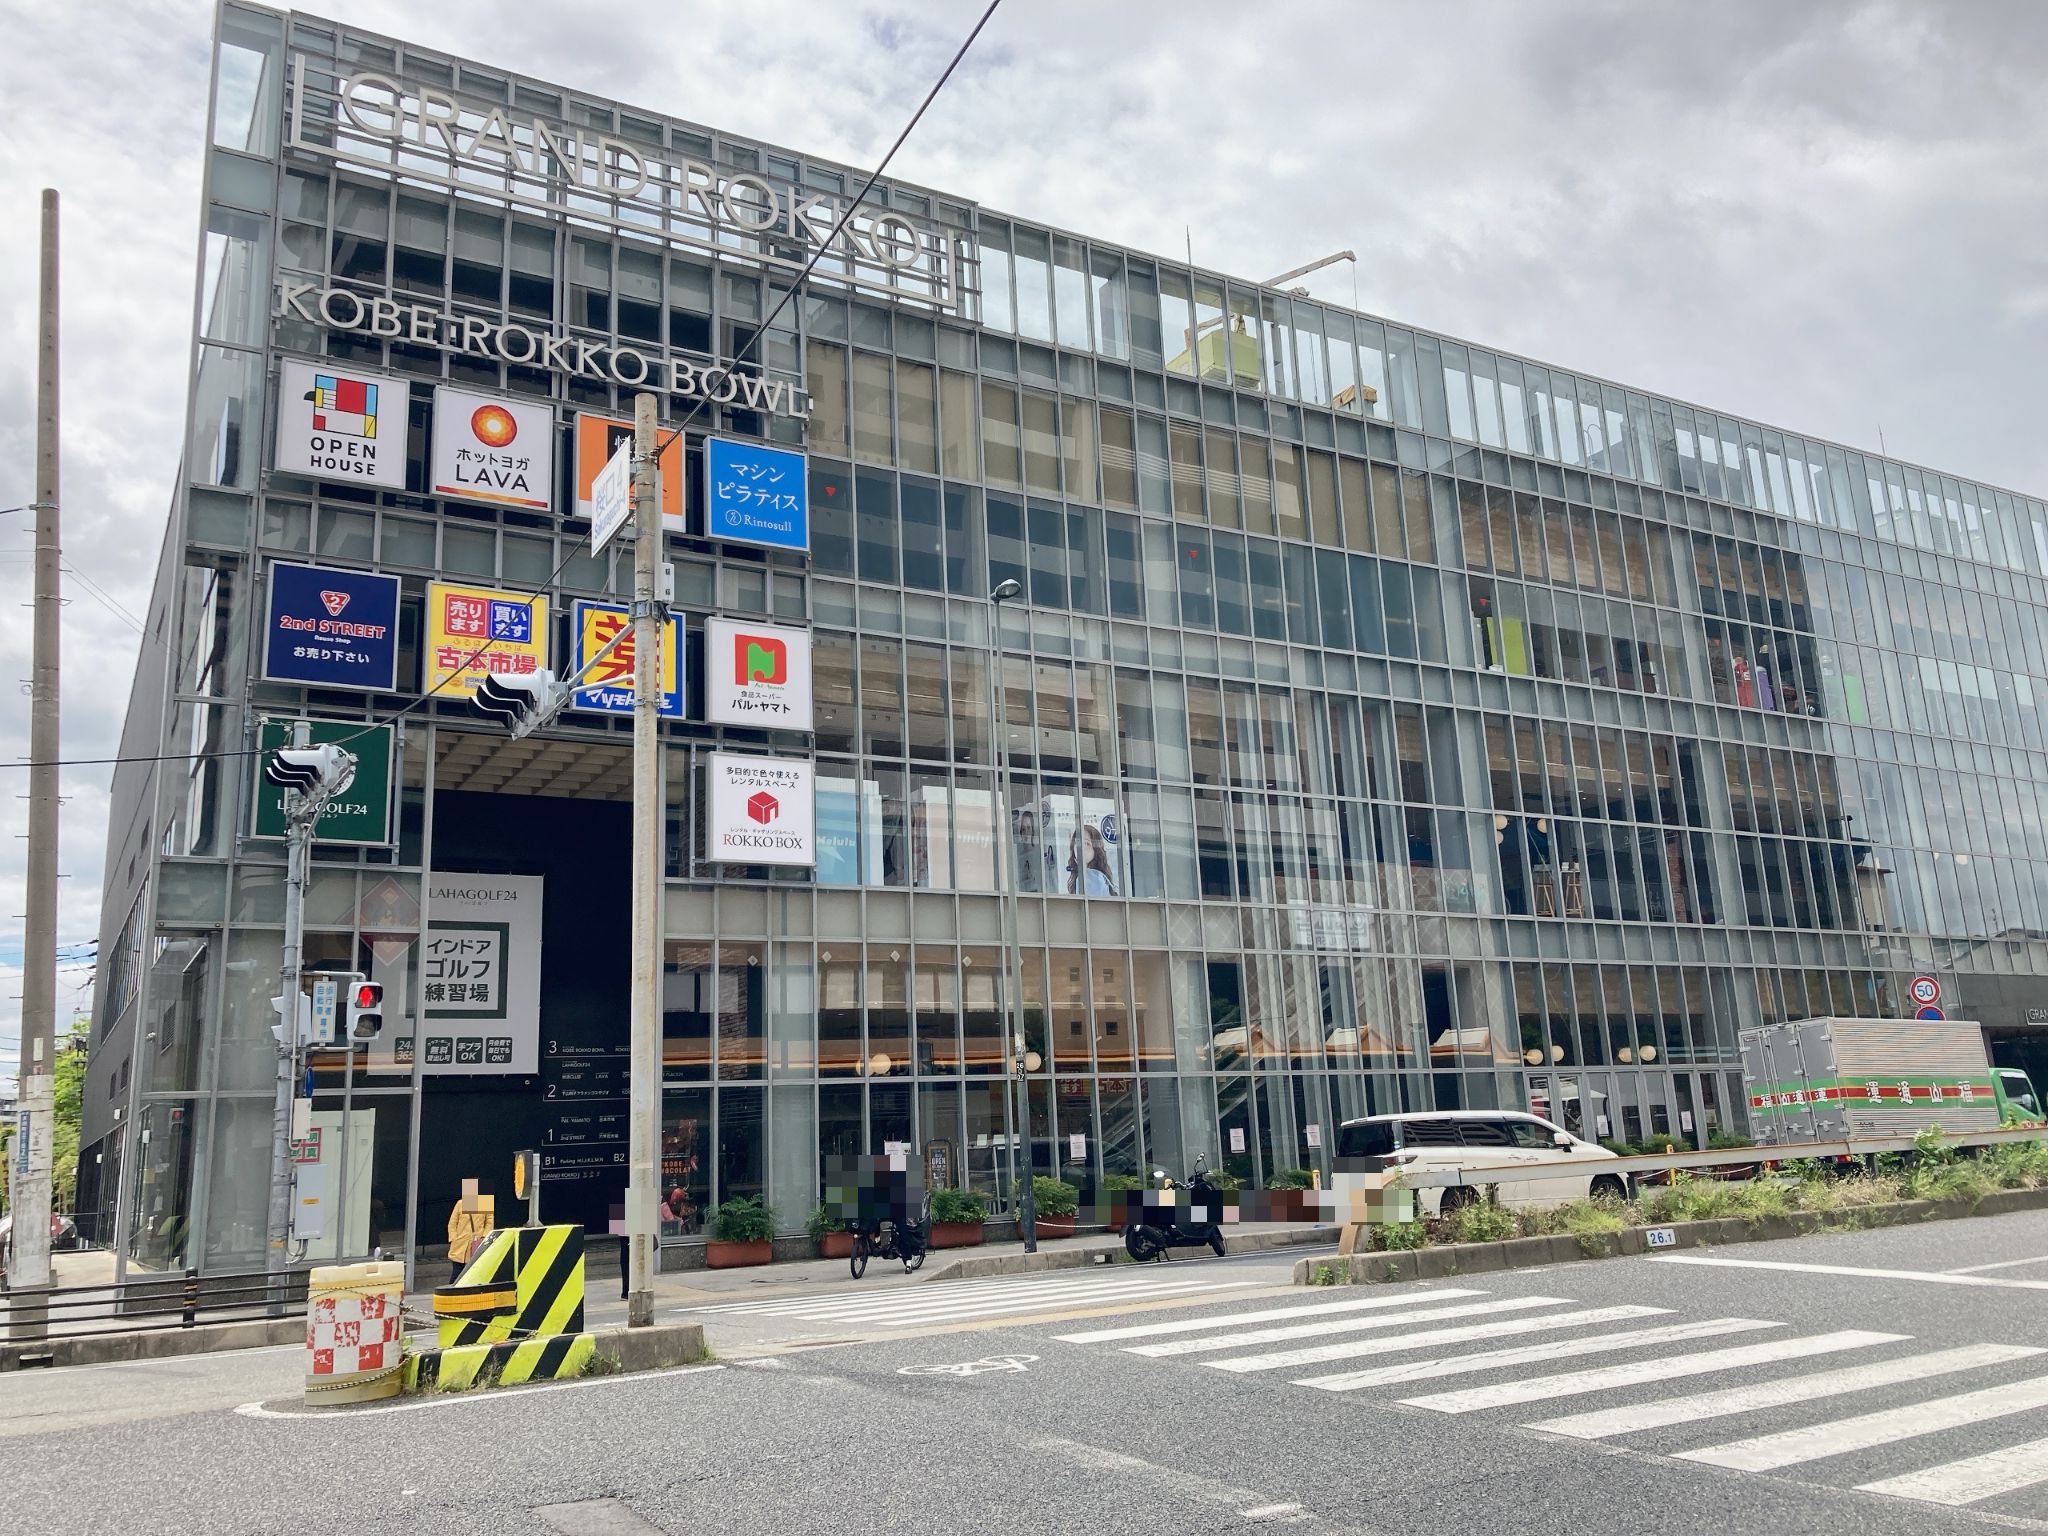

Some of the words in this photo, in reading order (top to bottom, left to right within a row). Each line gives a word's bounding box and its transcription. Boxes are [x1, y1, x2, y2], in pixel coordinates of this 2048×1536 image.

[342, 72, 649, 200] GRAND
[680, 159, 922, 270] ROKKO
[279, 279, 437, 345] KOBE
[462, 315, 648, 386] ROKKO
[671, 360, 809, 419] BOWL
[310, 436, 376, 459] OPEN
[311, 455, 376, 475] HOUSE
[456, 448, 530, 471] ホットヨガ
[456, 464, 530, 492] LAVA
[730, 463, 786, 483] マシン
[718, 482, 799, 511] ピラティス
[744, 514, 792, 532] Rintosull
[450, 601, 482, 618] 売り
[494, 605, 527, 622] 買い
[280, 615, 315, 632] 2nd
[319, 620, 385, 639] STREET
[451, 618, 483, 632] ます
[495, 622, 527, 637] ます
[293, 647, 370, 664] お売り下さい
[437, 646, 537, 675] 古本市場
[732, 699, 790, 713] パル・ヤマト
[726, 766, 800, 779] 多目的で色々使える
[731, 777, 796, 789] レンタルスペース
[723, 834, 773, 847] ROKKO
[776, 837, 802, 849] BOX
[429, 887, 518, 900] LAHAGOLF24
[427, 938, 491, 955] インドア
[426, 957, 490, 979] ゴルフ
[425, 982, 489, 1002] 練習場
[1917, 984, 1933, 998] 50
[548, 1040, 557, 1054] 3
[461, 1052, 477, 1060] OK
[547, 1084, 556, 1098] 2
[547, 1129, 552, 1141] 1
[545, 1156, 555, 1165] B1
[614, 1153, 624, 1161] B2
[1650, 1232, 1672, 1244] 26.1
